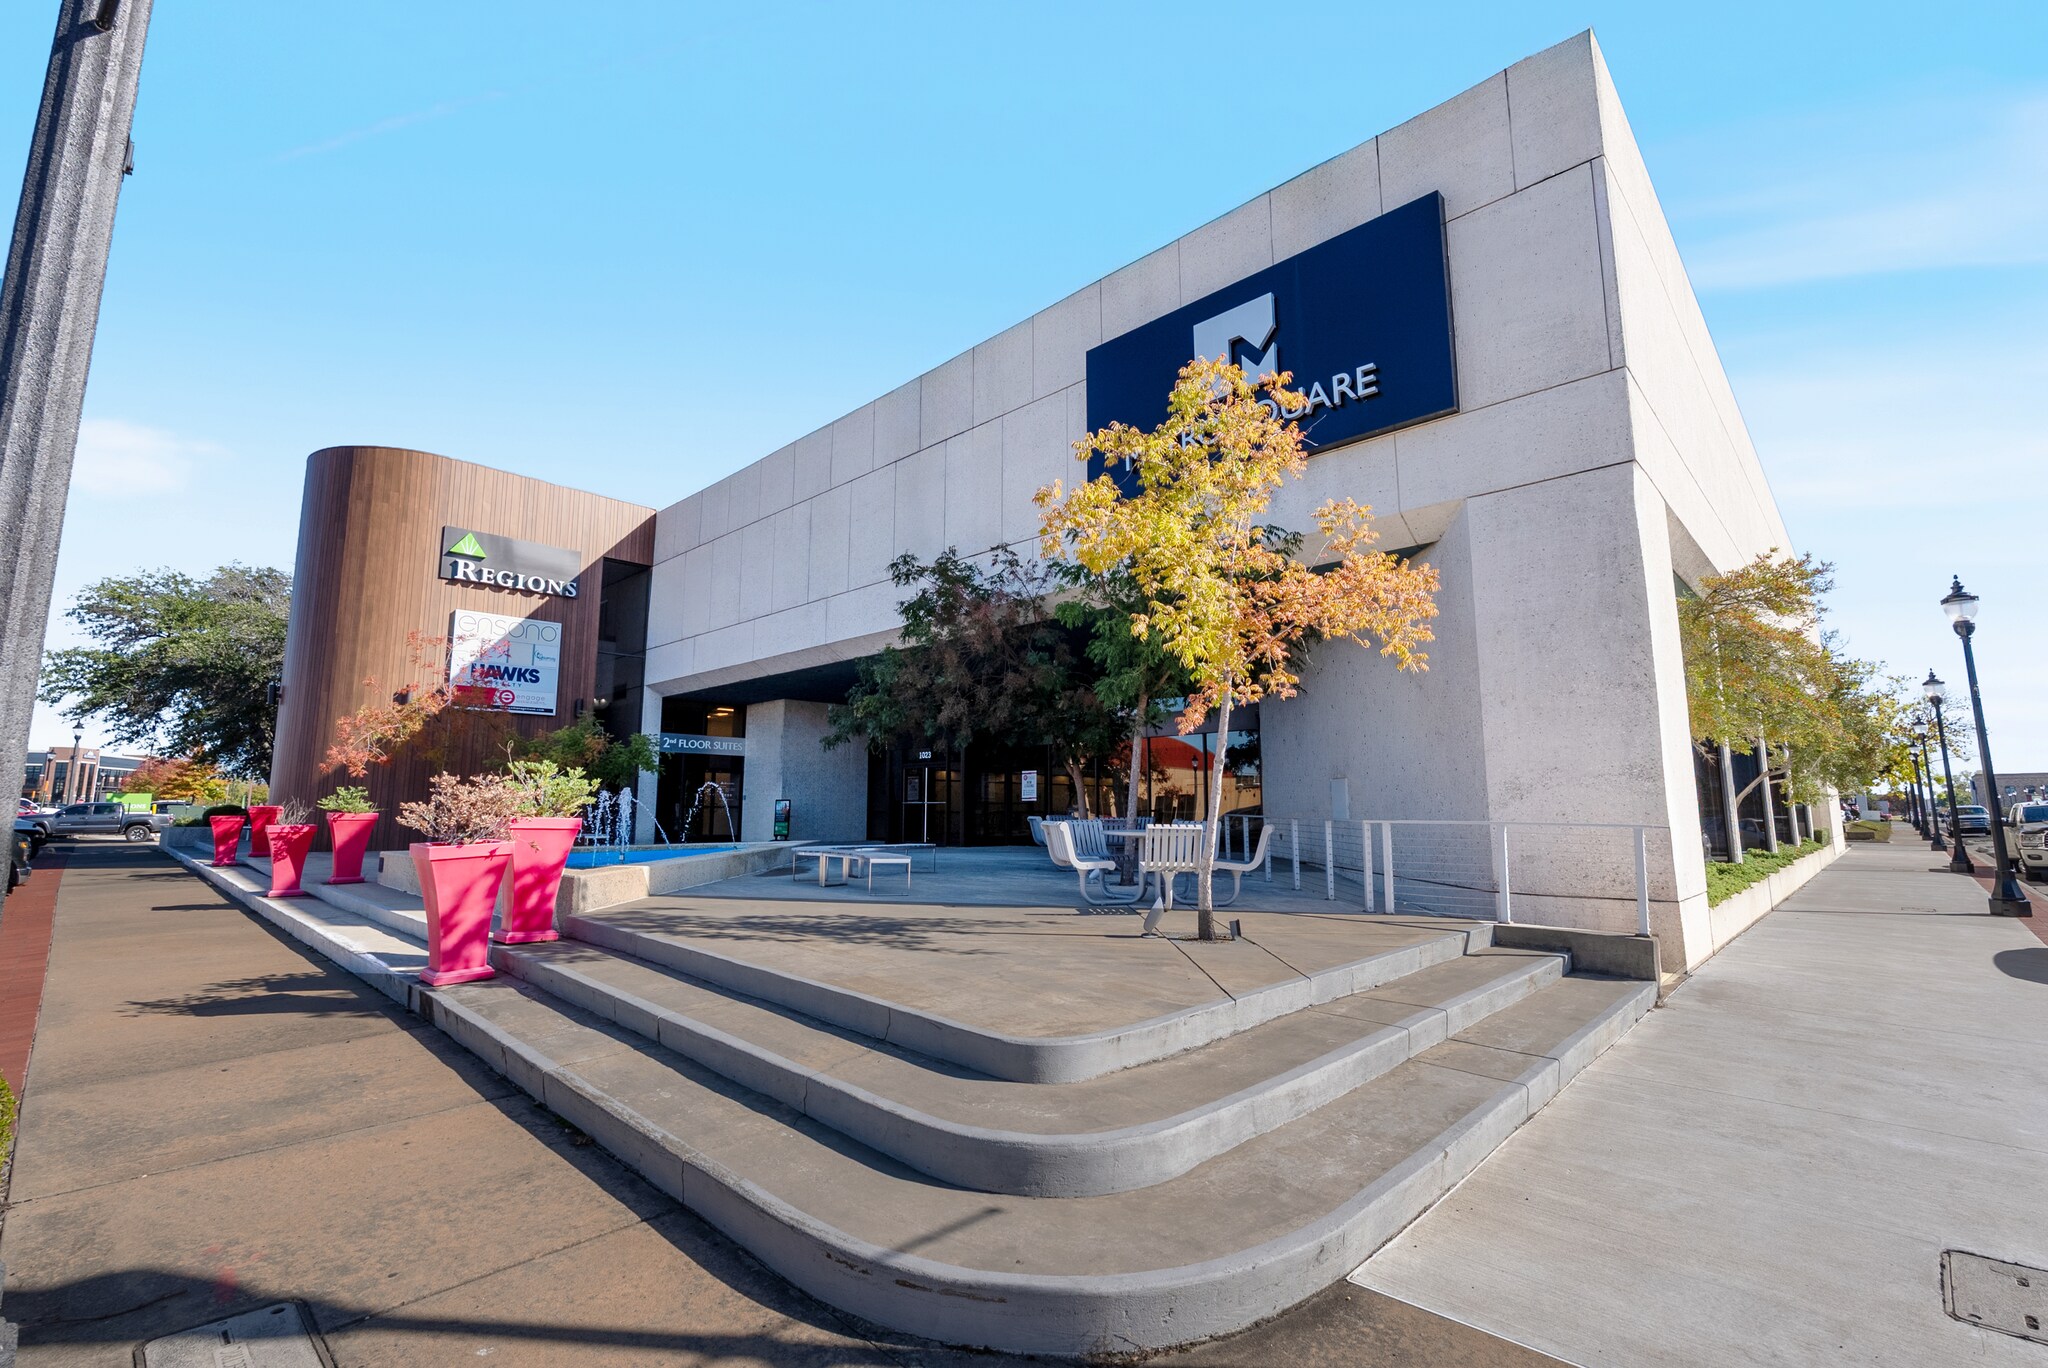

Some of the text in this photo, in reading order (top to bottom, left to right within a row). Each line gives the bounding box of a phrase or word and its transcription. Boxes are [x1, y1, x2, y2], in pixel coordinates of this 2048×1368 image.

[1250, 362, 1378, 424] UARE
[454, 559, 577, 597] REGIONS
[458, 616, 557, 642] ensono
[663, 737, 743, 751] 2nd FLOOR SUITES
[919, 751, 932, 759] 1023
